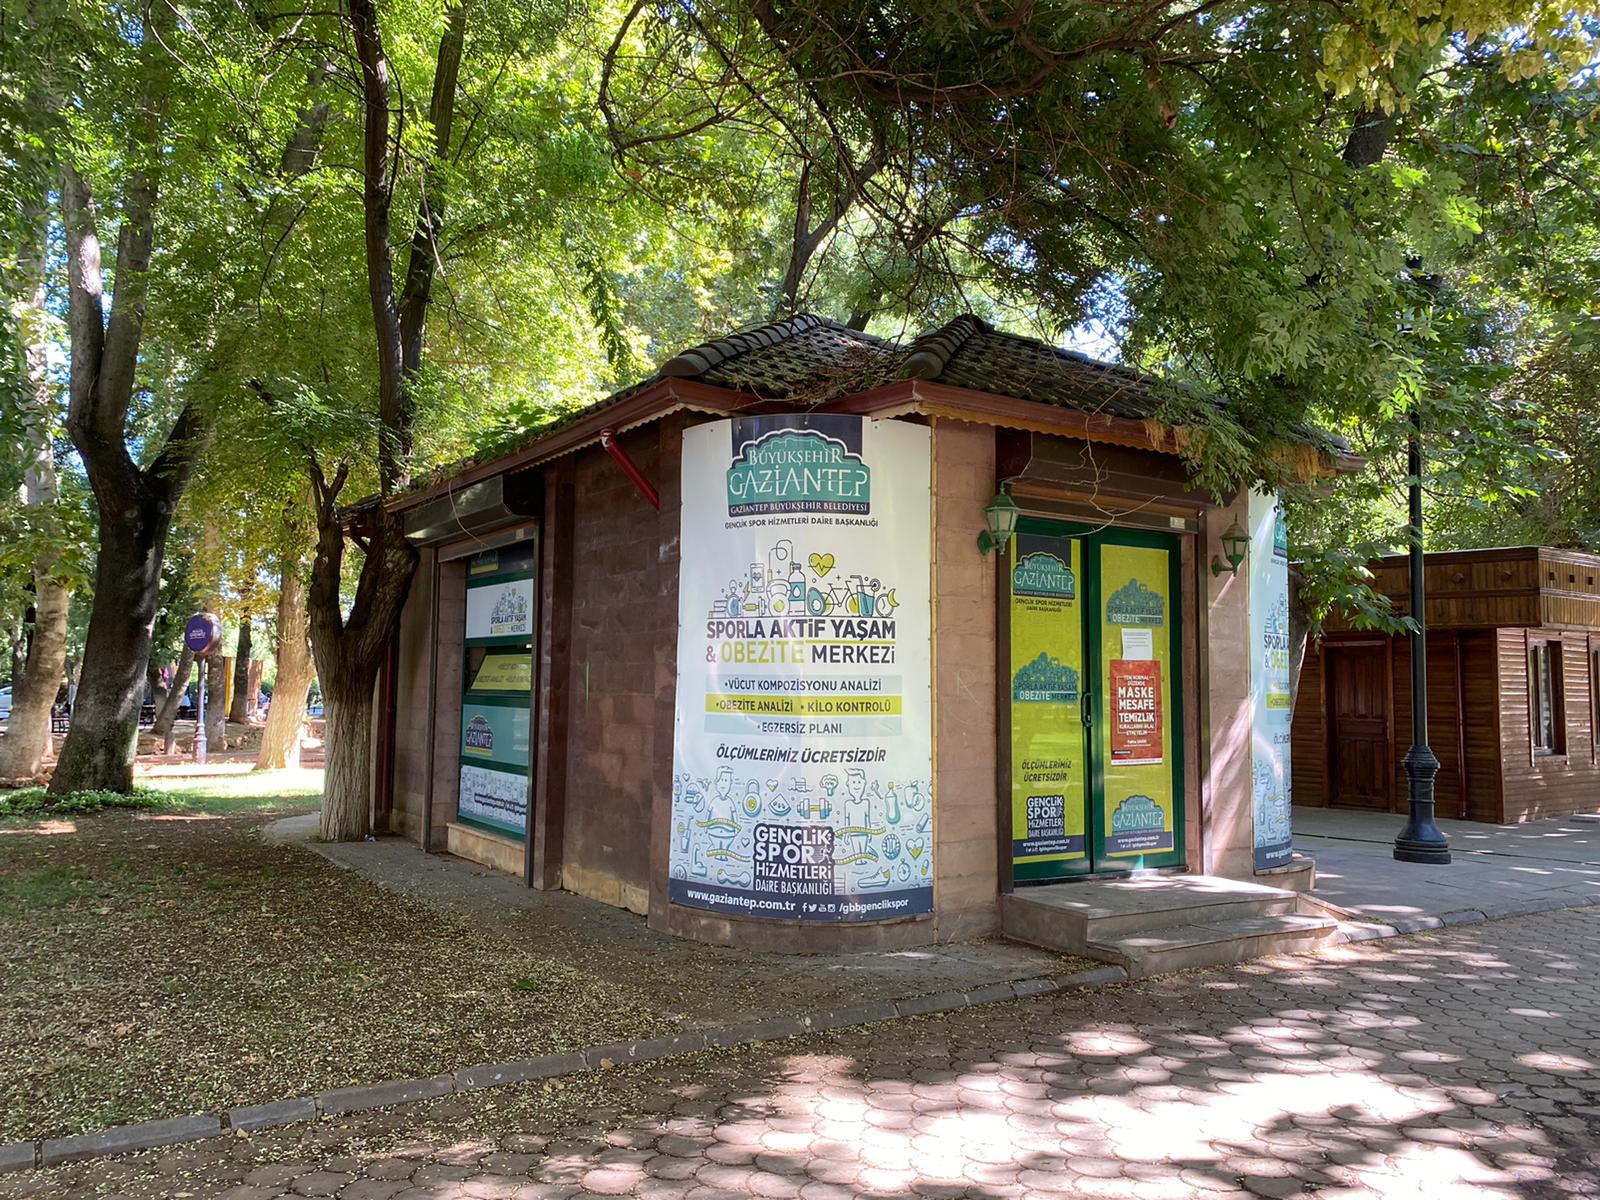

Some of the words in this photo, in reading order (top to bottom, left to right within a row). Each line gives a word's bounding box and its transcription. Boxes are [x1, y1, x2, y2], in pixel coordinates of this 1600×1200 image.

[749, 447, 843, 466] BÜYÜKŞEHİR
[729, 464, 868, 499] GAZİANTEP
[730, 503, 769, 514] GAZİANTEP
[770, 501, 822, 513] BÜYÜKŞEHİR
[823, 502, 867, 512] BELEDİYESİ
[724, 518, 748, 529] GENÇLİK
[748, 517, 767, 527] SPOR
[768, 515, 809, 526] HİZMETLERİ
[811, 515, 833, 525] DAİRE
[835, 517, 879, 527] BAŞKANLIĞI
[1014, 570, 1075, 591] GAZİANTEP
[706, 619, 766, 639] SPORLA
[830, 619, 896, 641] YAŞAM
[705, 645, 716, 663] &
[728, 677, 756, 690] VÜCUT
[757, 678, 838, 691] KOMPOZİSYONU
[840, 678, 882, 691] ANALİZİ
[1118, 686, 1154, 698] MASKE
[757, 699, 793, 712] ANALİZİ
[807, 700, 833, 712] KİLO
[836, 699, 891, 712] KONTROLÜ
[1118, 699, 1155, 710] MESAFE
[761, 721, 806, 734] EGZERSİZ
[809, 723, 842, 734] PLANI
[716, 744, 799, 763] ÖLÇÜMLERİMİZ
[801, 746, 886, 763] ÜCRETSİZDİR
[1024, 771, 1068, 783] ÜCRETSİZDİR
[1027, 807, 1057, 819] SPOR
[1113, 811, 1164, 829] GAZİANTEP
[755, 842, 816, 864] SPOR
[780, 879, 832, 897] BAŞKANLIĞI
[687, 889, 796, 911] www.gaziantep.com.tr
[838, 898, 909, 915] /gbbgenclikspor
